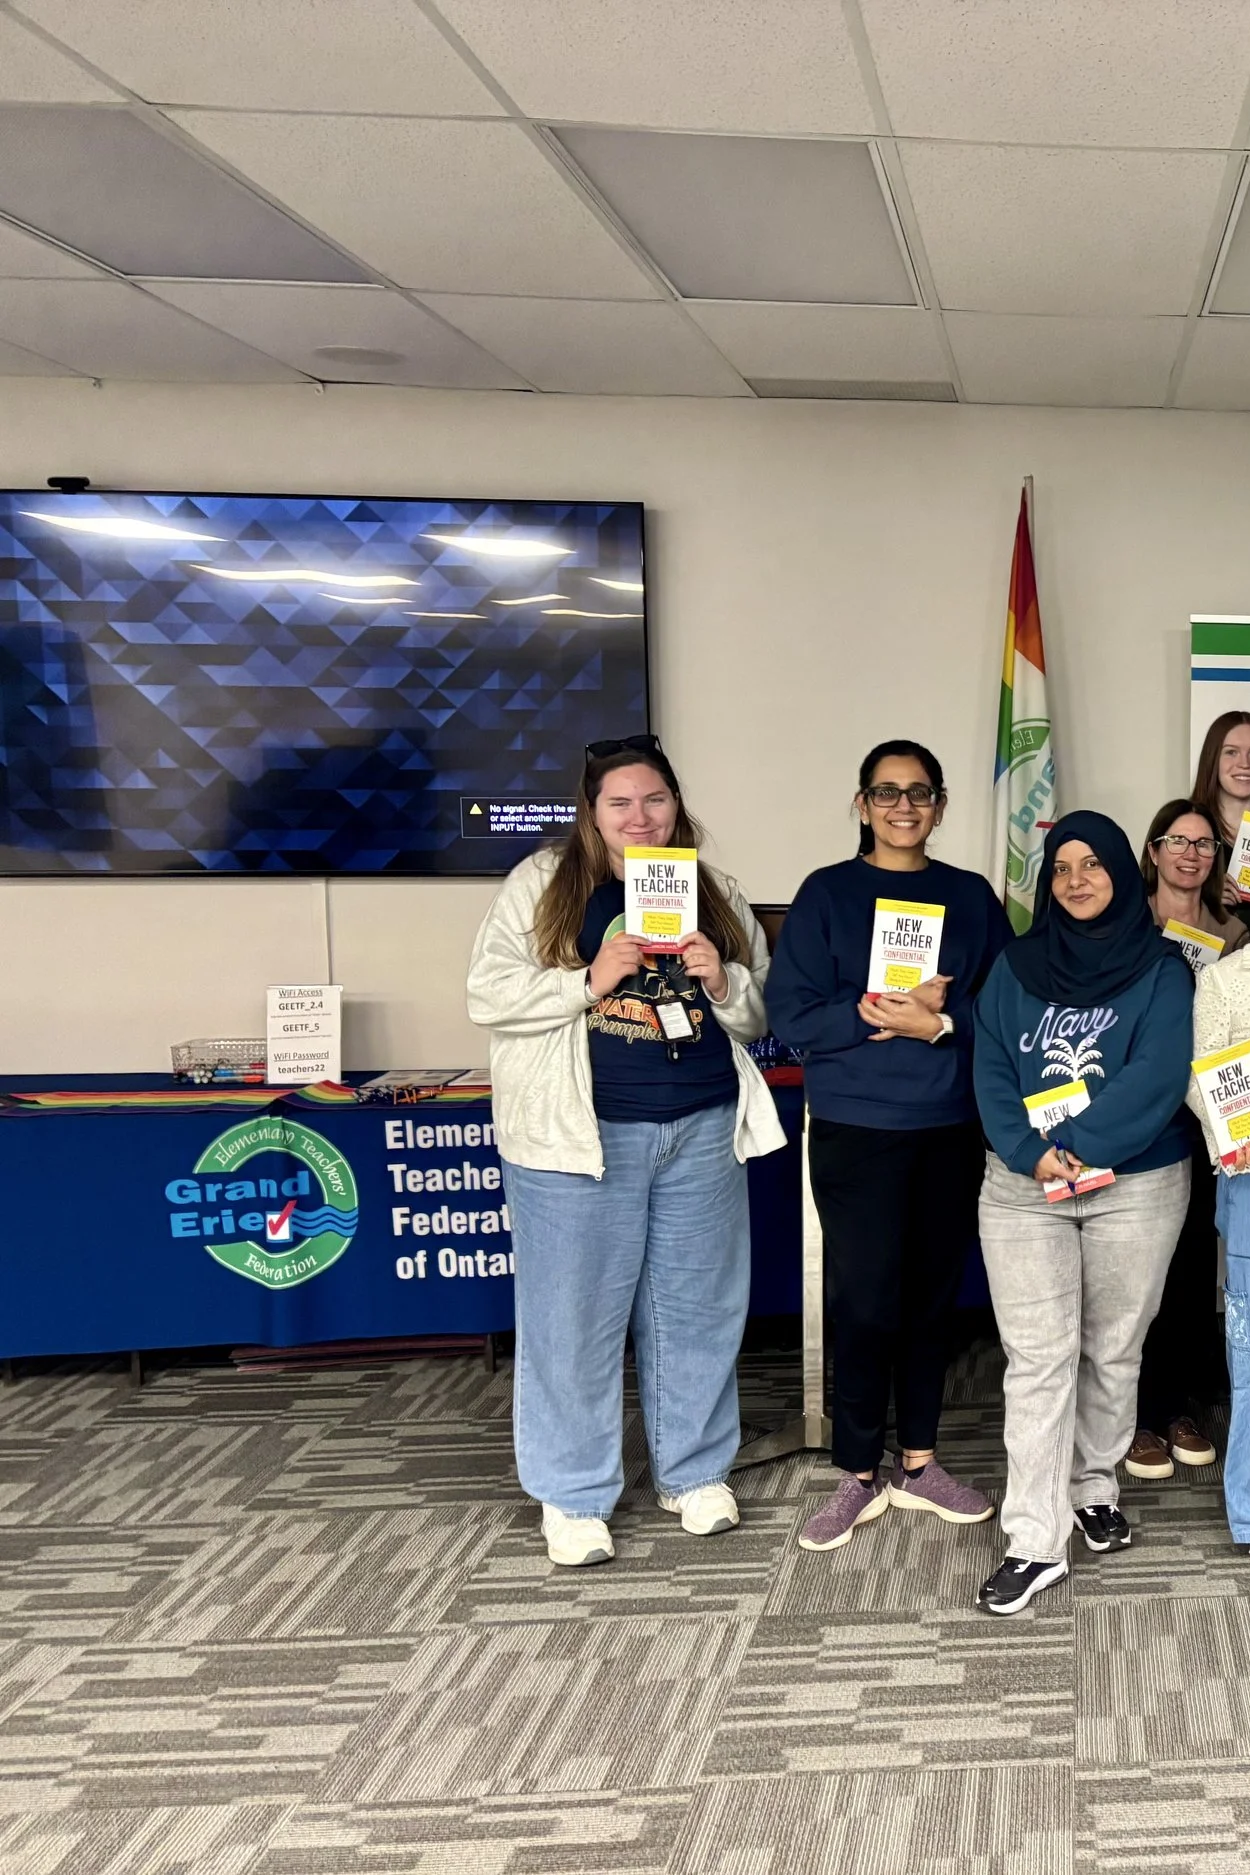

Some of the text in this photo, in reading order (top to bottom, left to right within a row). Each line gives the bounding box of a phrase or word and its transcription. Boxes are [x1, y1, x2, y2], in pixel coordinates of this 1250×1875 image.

[489, 804, 577, 815] No signal. Check the ex
[490, 815, 499, 823] or
[500, 814, 523, 823] select
[524, 814, 553, 823] another
[490, 823, 543, 832] INPUT button.
[647, 863, 675, 879] NEW
[633, 878, 689, 894] TEACHER
[638, 897, 684, 907] CONFIDENTIAL
[896, 917, 922, 933] NEW
[881, 930, 933, 950] TEACHER
[883, 950, 927, 962] CONFIDENTIAL
[297, 988, 323, 998] Access
[278, 1001, 323, 1011] GEETF_2.4
[592, 997, 703, 1025] WATERD
[282, 1023, 320, 1032] GEETF_5
[1019, 1005, 1119, 1053] Navy
[292, 1051, 329, 1060] Password
[278, 1064, 326, 1074] teachers22
[1217, 1062, 1244, 1086] NEW
[1043, 1103, 1070, 1122] NEW
[384, 1119, 498, 1149] Elemen
[213, 1127, 347, 1196] Elementary Teachers'
[387, 1161, 501, 1193] Teache
[165, 1170, 310, 1204] Grand
[170, 1209, 265, 1238] Erie
[391, 1204, 511, 1236] Federat
[243, 1252, 317, 1281] Federation
[396, 1249, 427, 1280] of
